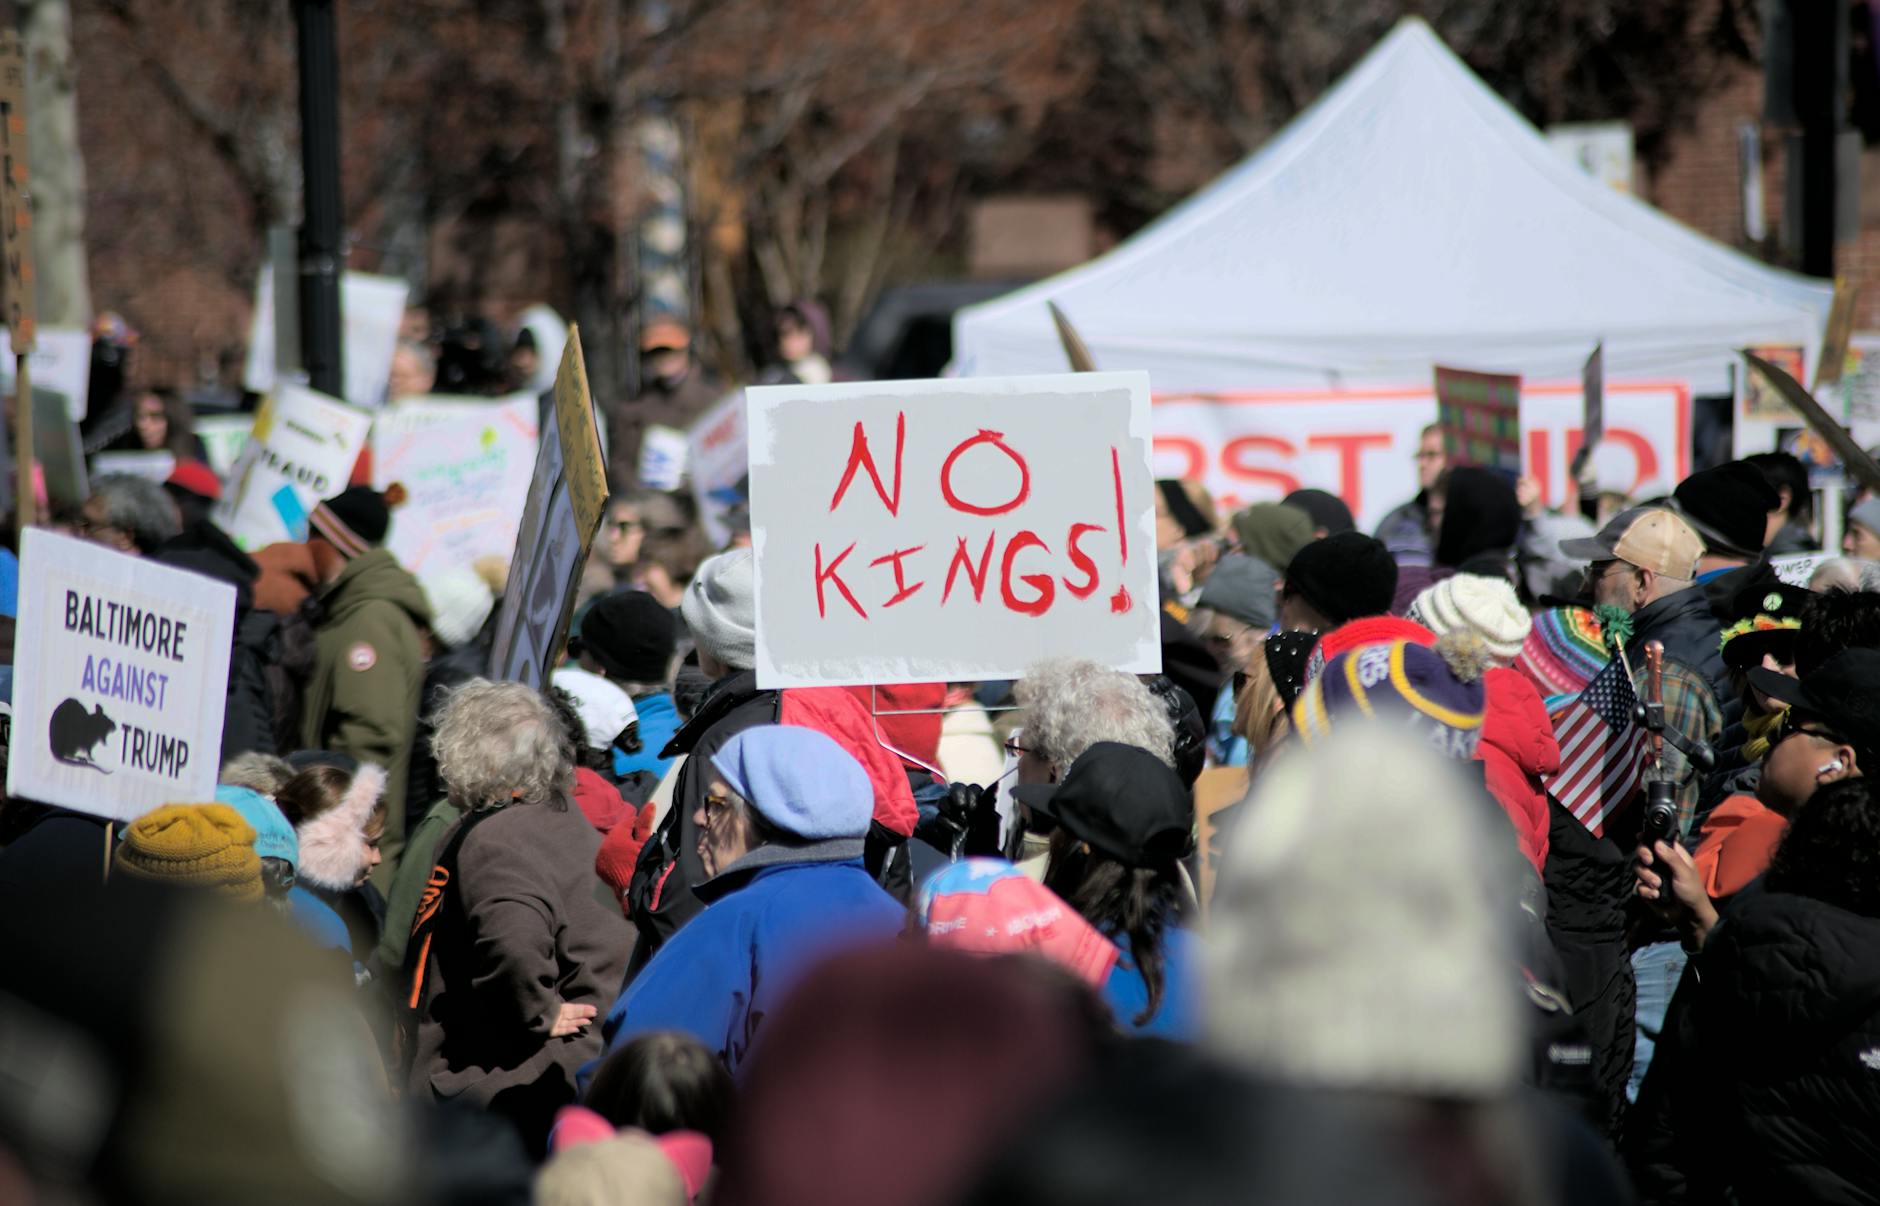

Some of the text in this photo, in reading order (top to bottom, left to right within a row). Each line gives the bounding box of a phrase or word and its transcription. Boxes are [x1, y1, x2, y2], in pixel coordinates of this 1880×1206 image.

[830, 410, 1031, 518] NO
[1528, 429, 1658, 508] ID
[814, 445, 1133, 621] KINGS!
[65, 589, 187, 664] BALTIMORE
[81, 653, 168, 712] AGAINST
[121, 722, 189, 780] TRUMP
